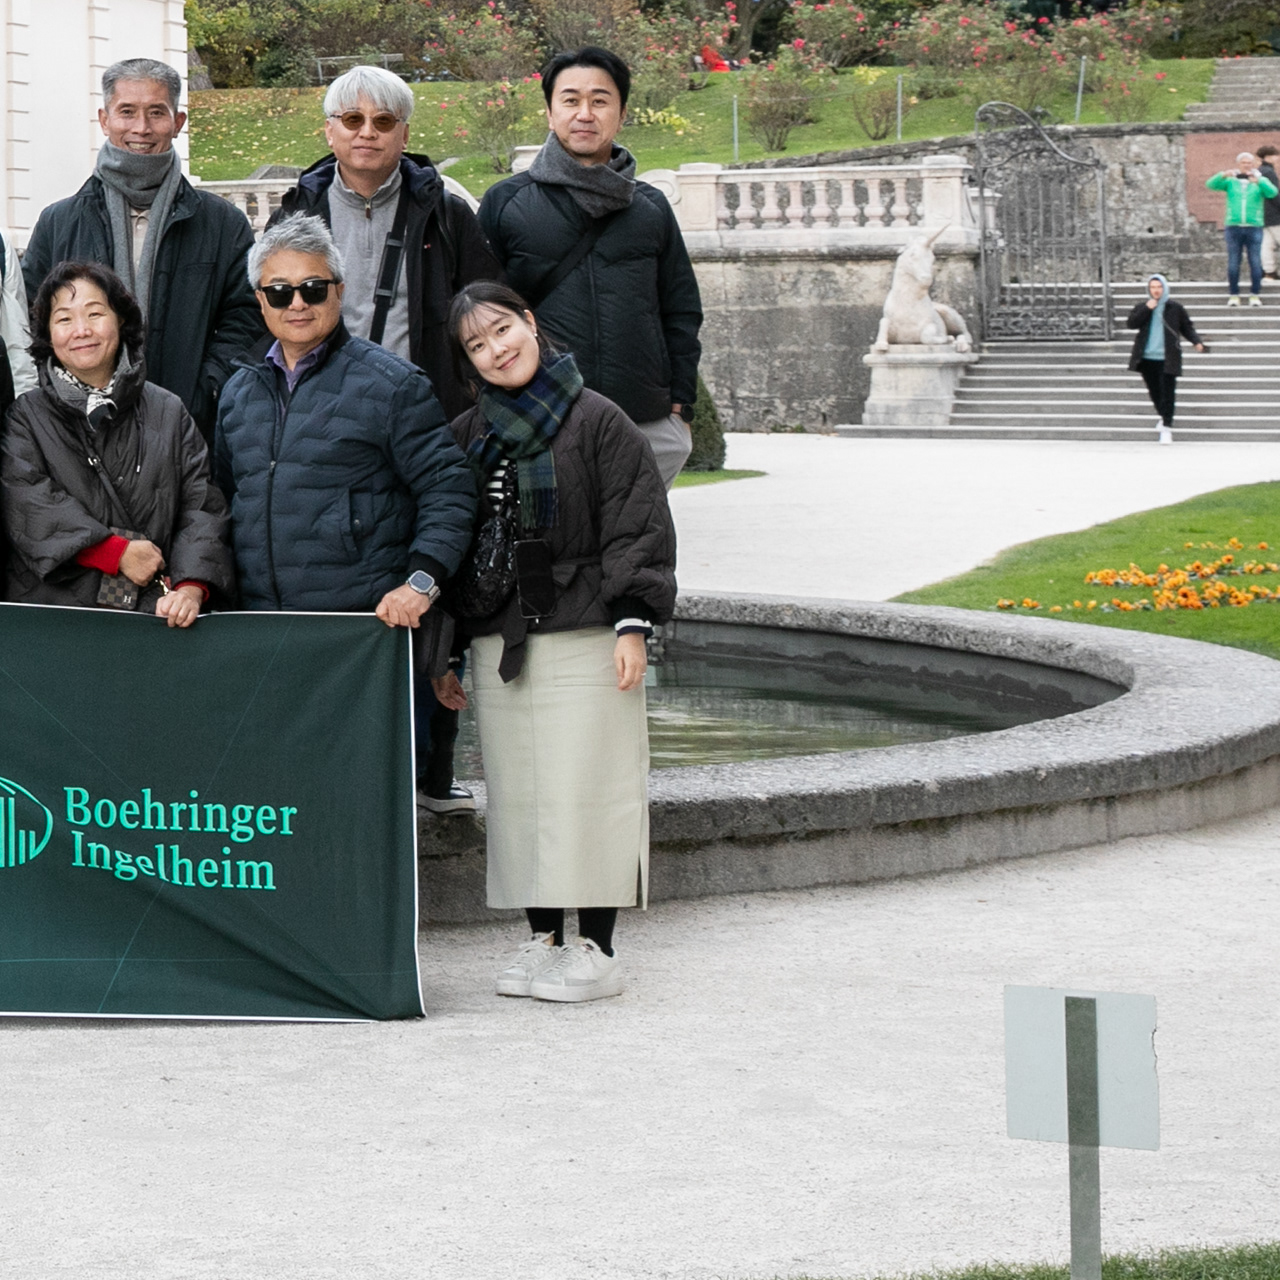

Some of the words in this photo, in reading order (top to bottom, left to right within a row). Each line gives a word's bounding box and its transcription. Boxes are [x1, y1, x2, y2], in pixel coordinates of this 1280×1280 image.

[123, 595, 132, 604] H
[62, 785, 299, 843] Boehringer
[70, 829, 278, 891] Ingelheim
